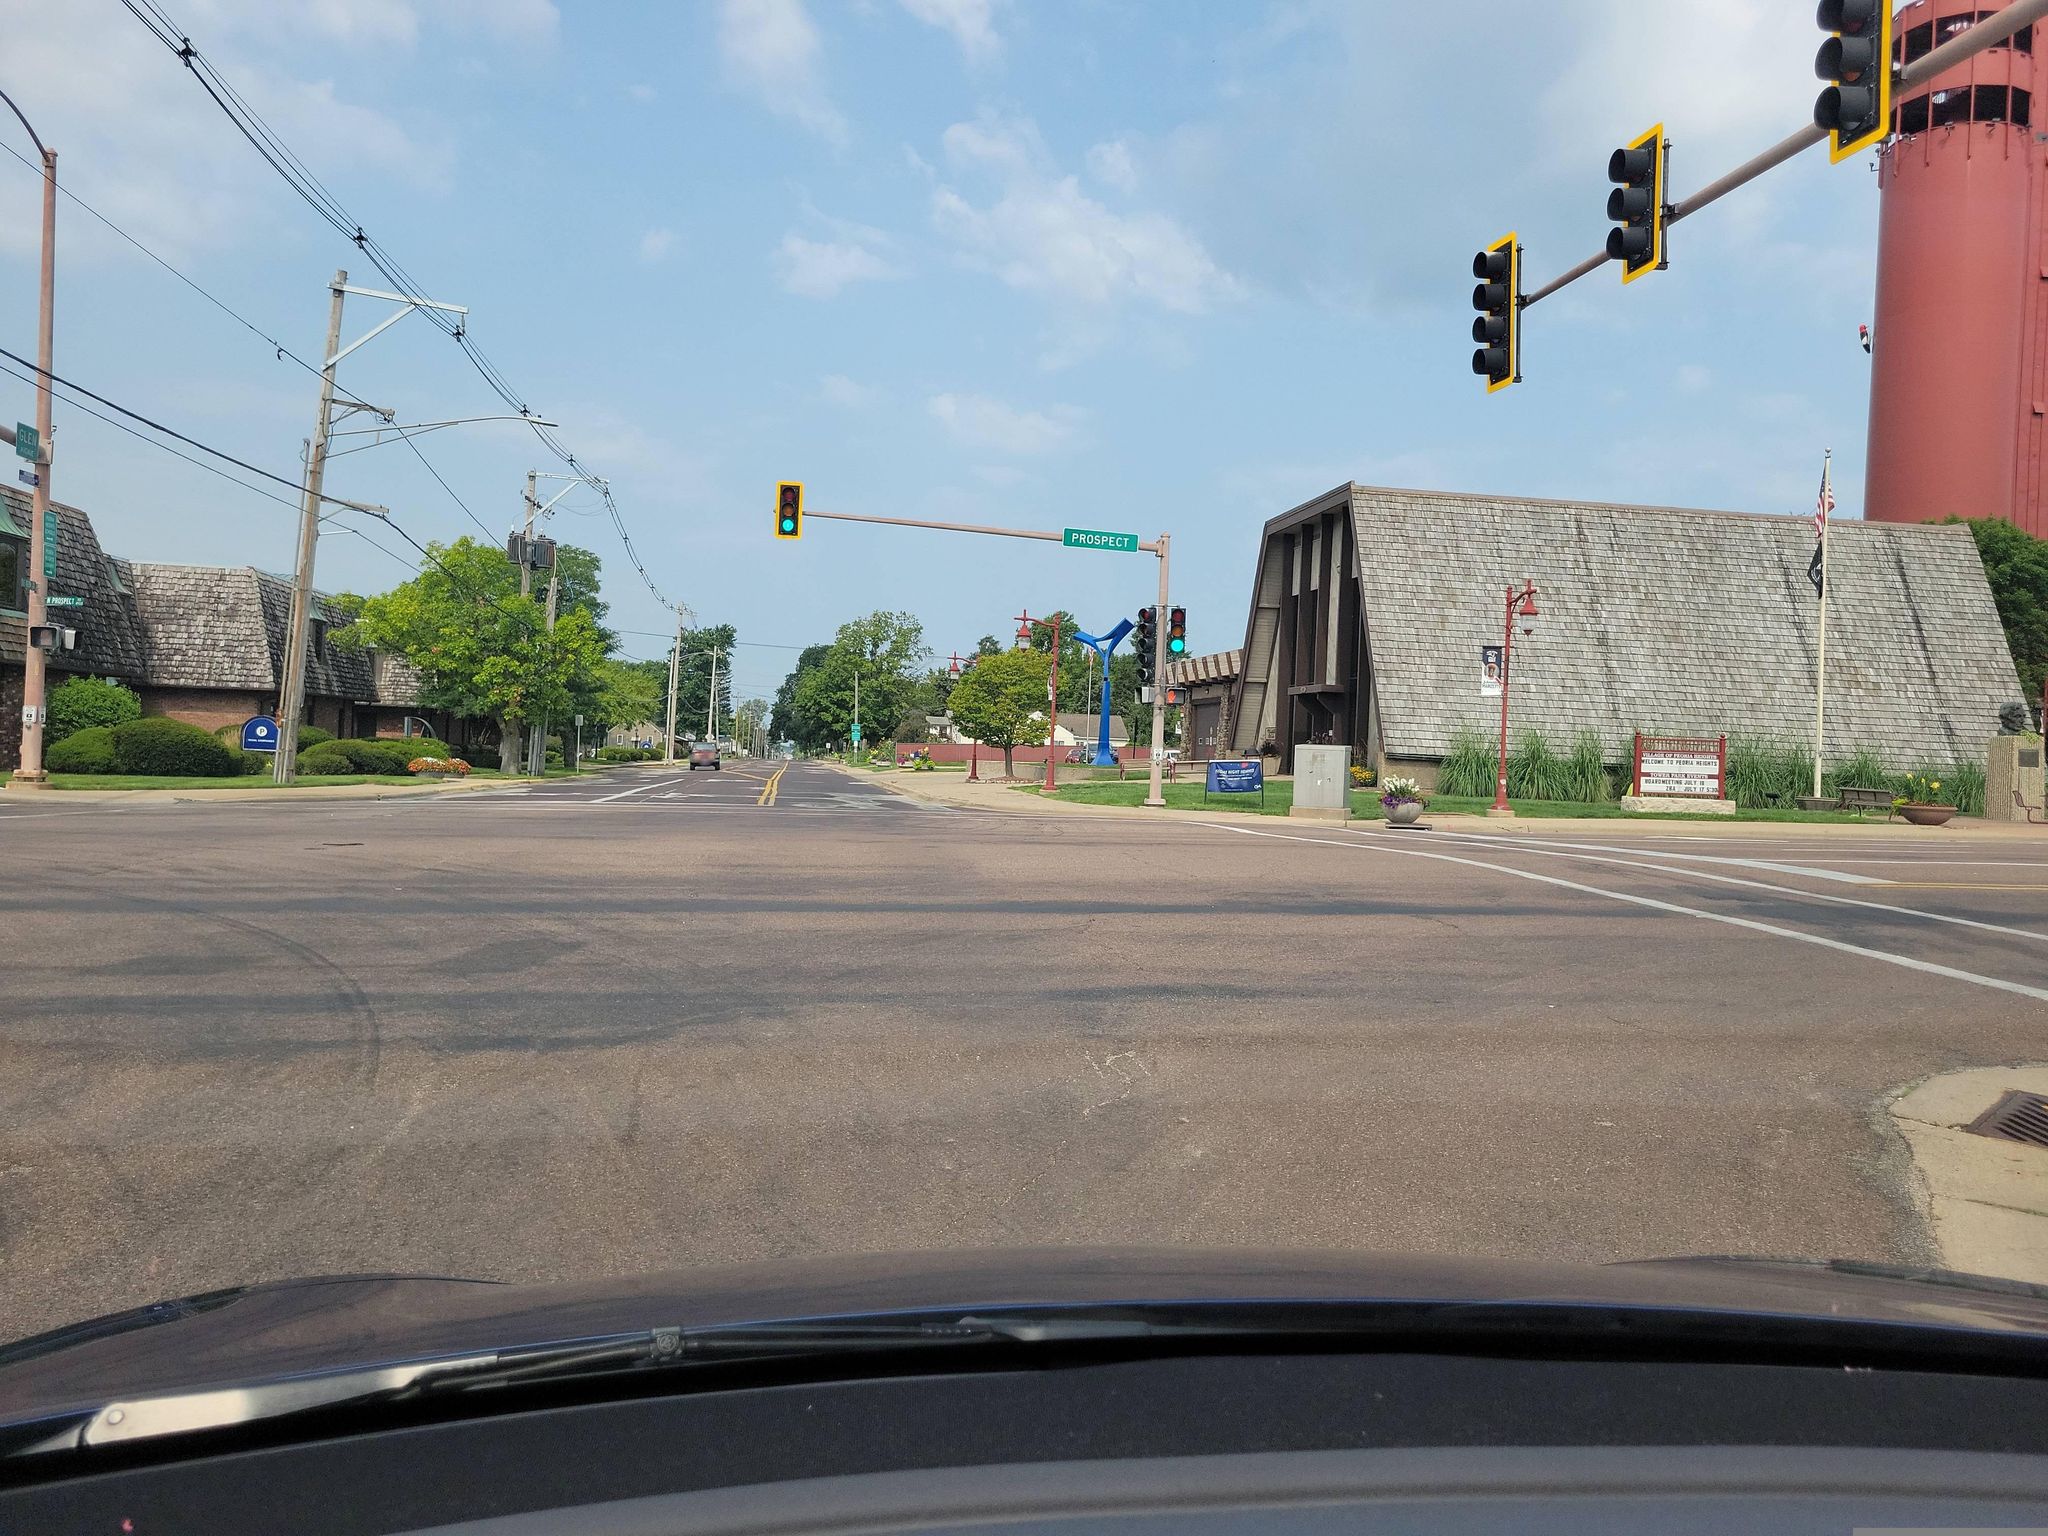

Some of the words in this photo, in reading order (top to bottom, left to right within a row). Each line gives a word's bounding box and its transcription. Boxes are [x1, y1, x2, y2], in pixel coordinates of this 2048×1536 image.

[19, 429, 37, 446] GLEN
[1071, 533, 1130, 548] PROSPECT
[51, 597, 75, 605] PROSPECT
